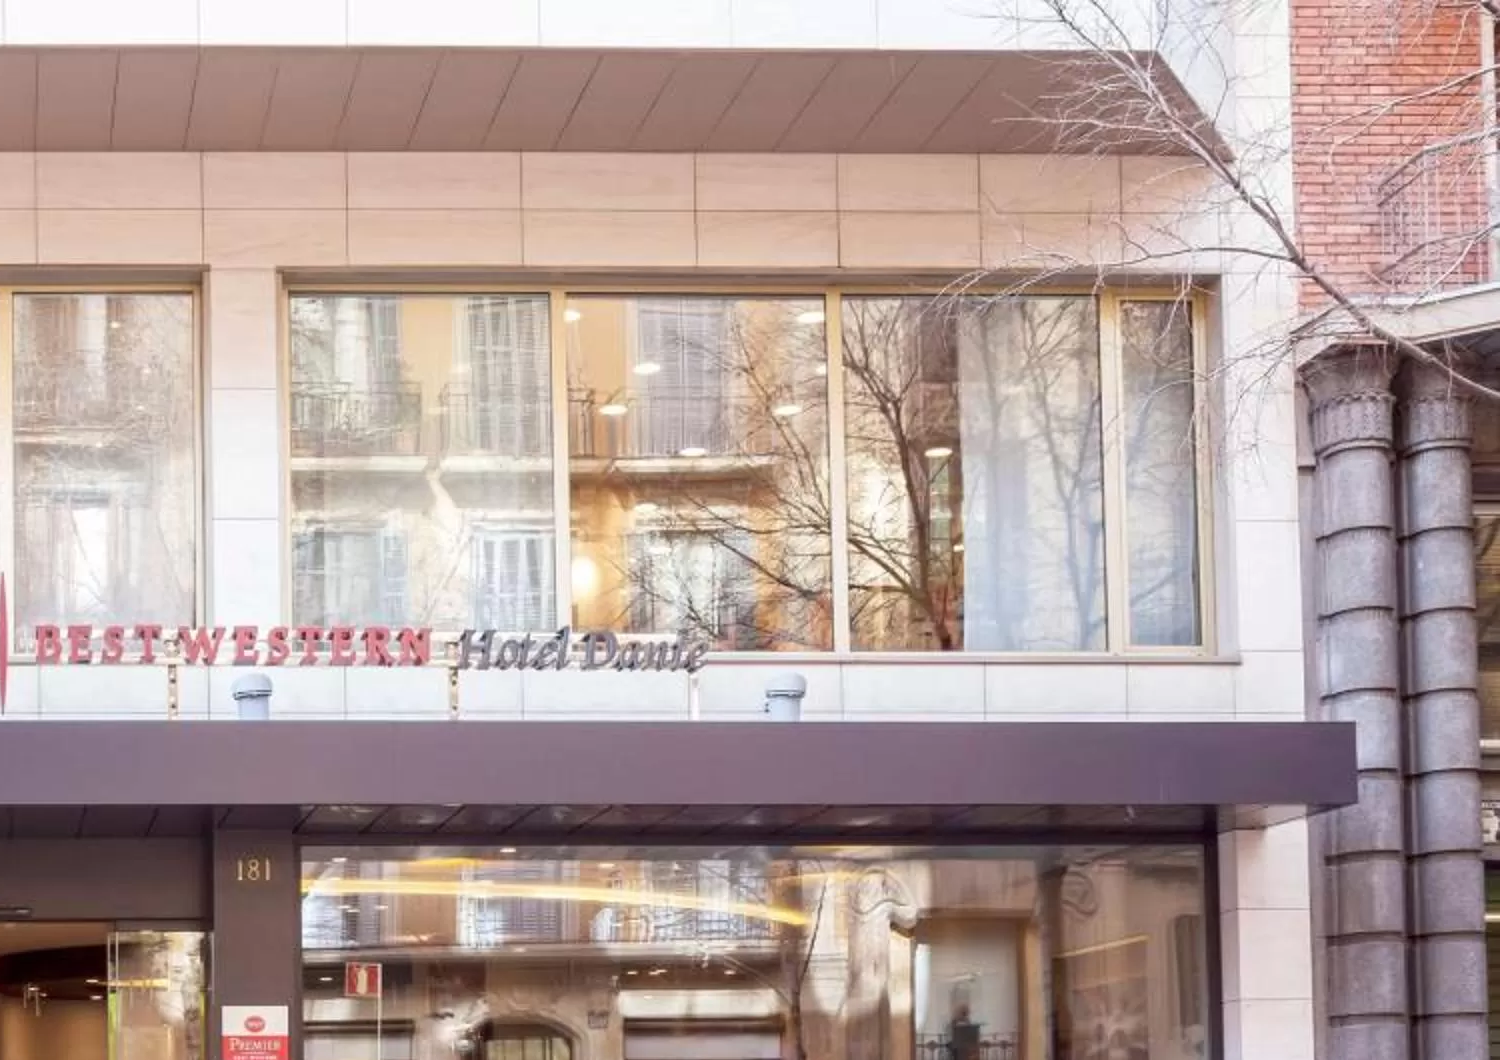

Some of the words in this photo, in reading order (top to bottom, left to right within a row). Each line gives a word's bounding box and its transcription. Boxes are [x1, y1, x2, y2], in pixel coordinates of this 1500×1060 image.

[35, 624, 164, 665] BEST
[179, 625, 433, 668] WESTERN
[457, 626, 571, 672] Hotel
[578, 630, 711, 674] Dante
[237, 858, 272, 881] 181
